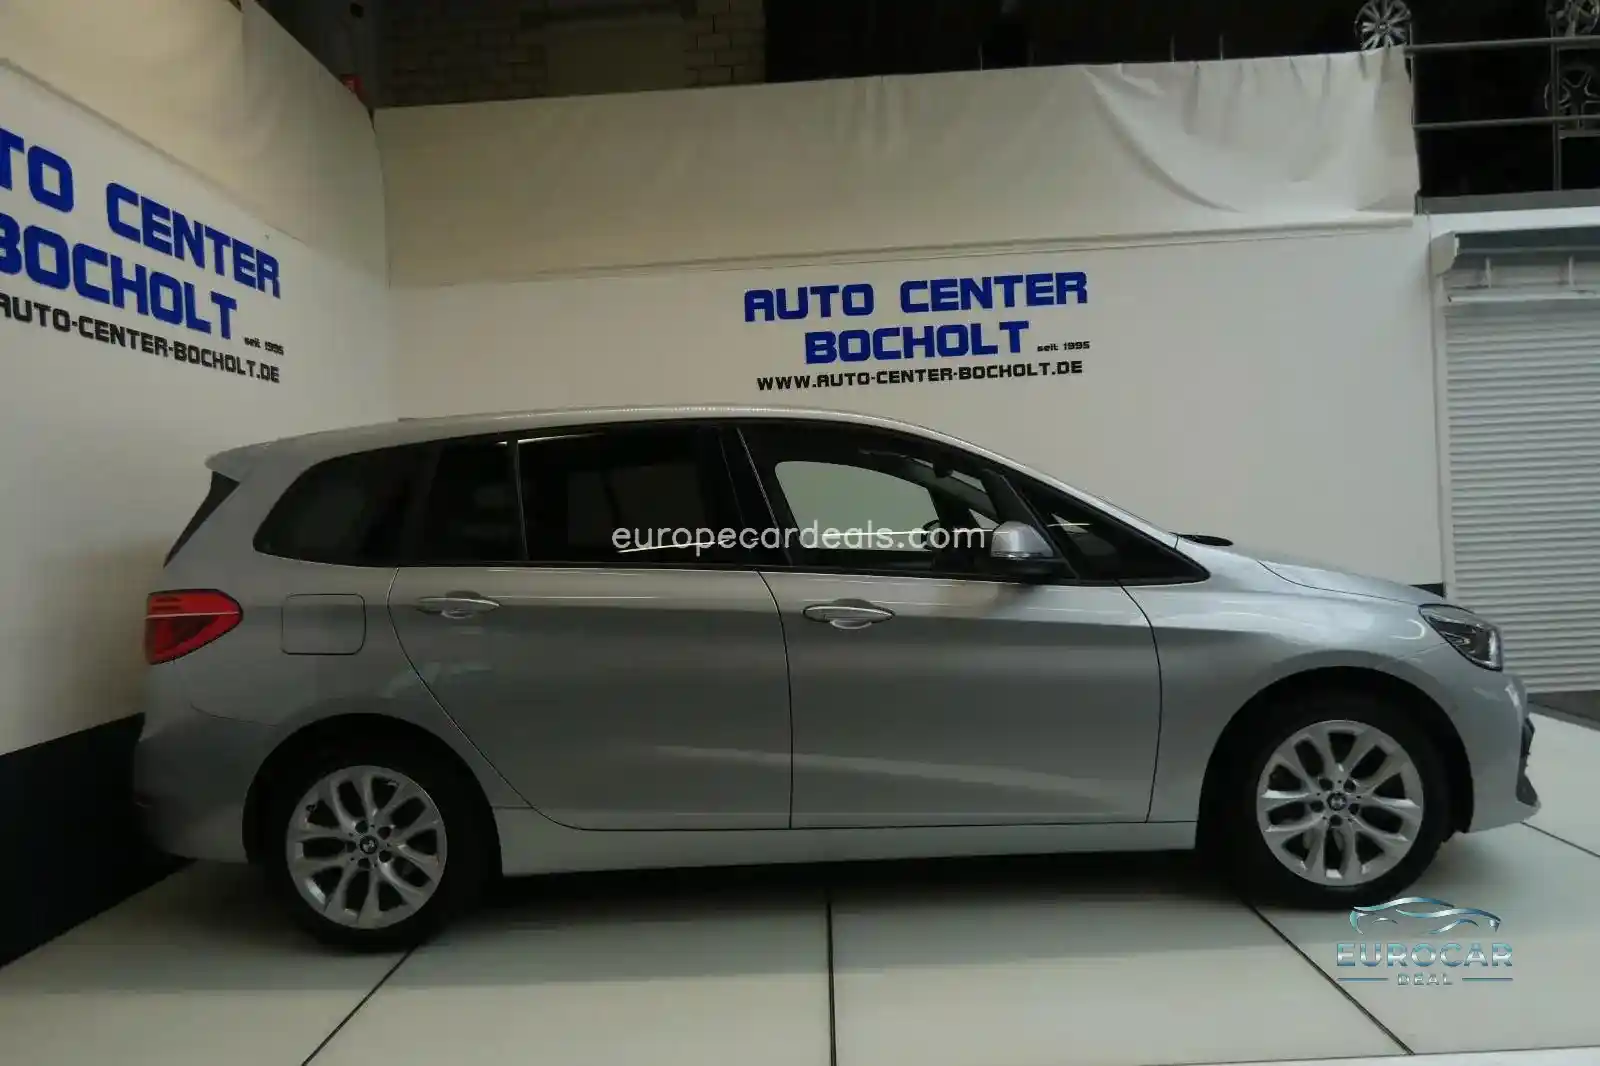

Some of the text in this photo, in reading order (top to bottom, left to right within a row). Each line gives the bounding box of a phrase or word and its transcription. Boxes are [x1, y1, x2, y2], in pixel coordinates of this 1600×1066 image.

[106, 182, 281, 300] CENTER
[744, 271, 1088, 322] AUTO CENTER
[804, 320, 1030, 364] BOCHOLT
[1036, 340, 1091, 353] seit 1995
[756, 360, 1083, 391] WWW.AUTO-CENTER-BOCHOLT.DE
